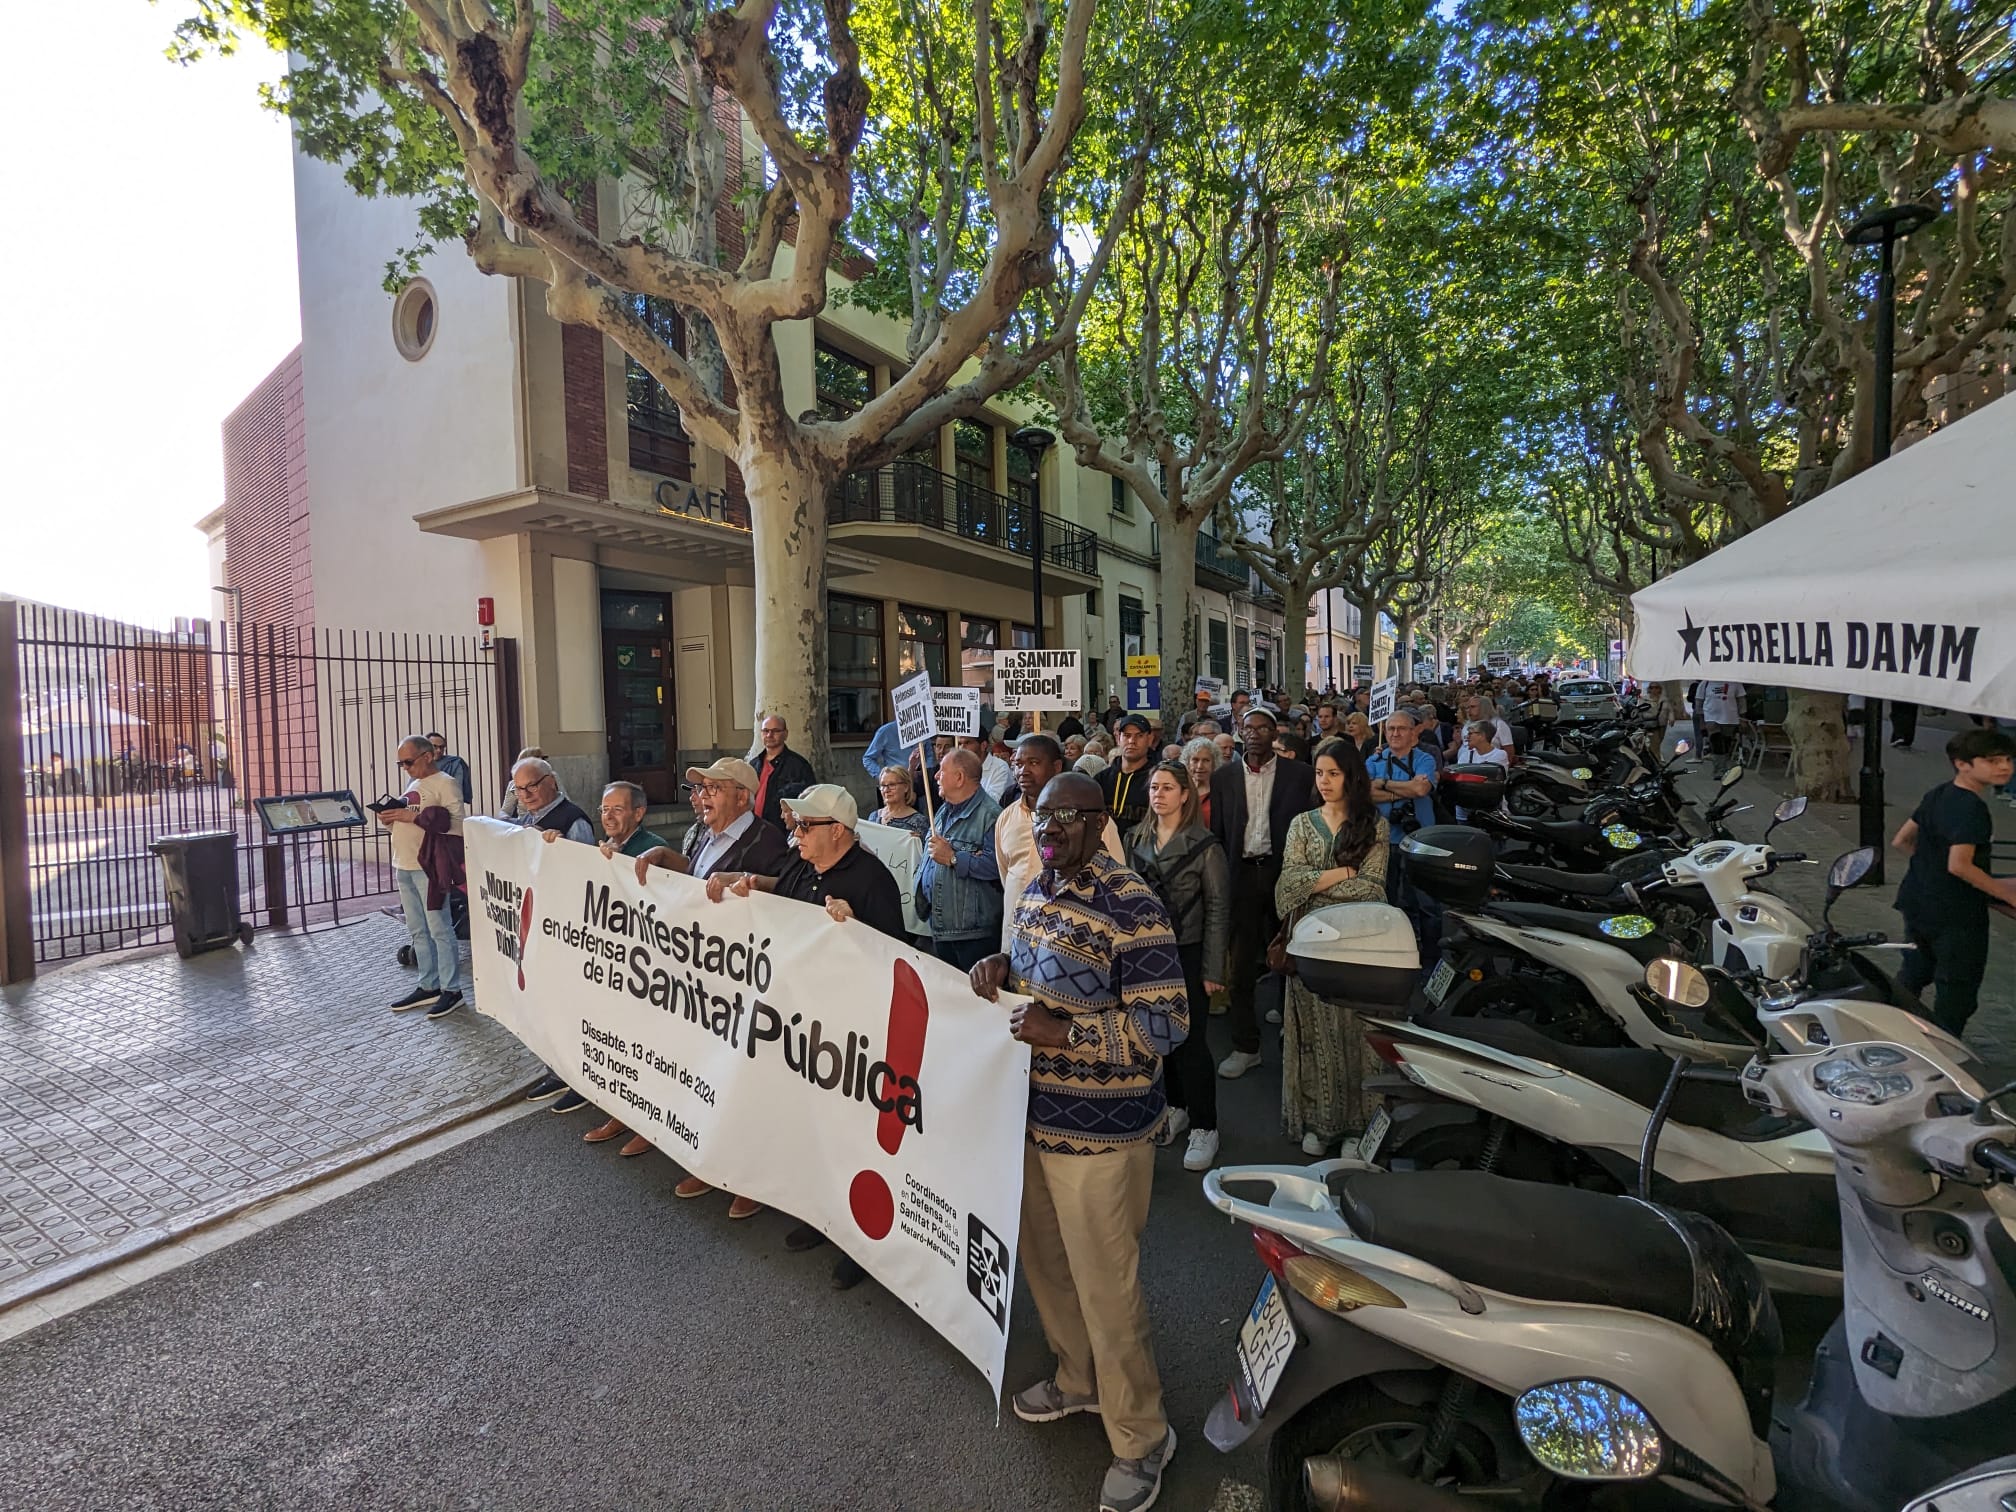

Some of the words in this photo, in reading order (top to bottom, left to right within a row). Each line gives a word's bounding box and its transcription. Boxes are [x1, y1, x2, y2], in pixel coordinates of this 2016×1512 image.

[998, 668, 1010, 679] no
[1028, 669, 1041, 679] un
[1005, 656, 1015, 668] la
[1018, 651, 1077, 668] SANITAT
[1709, 621, 1834, 667] ESTRELLA
[1846, 621, 1981, 683] DAMM
[934, 691, 962, 700] defensem
[1004, 675, 1063, 699] NEGOCI!
[898, 702, 922, 727] SANITAT
[934, 706, 966, 718] SANITAT
[542, 917, 561, 940] en
[563, 921, 626, 963] defensa
[583, 880, 773, 994] Manifestació
[582, 1041, 605, 1066] 18:30
[607, 1054, 639, 1082] hores
[583, 957, 604, 984] de
[609, 963, 624, 992] la
[627, 945, 745, 1049] Sanitat
[747, 999, 924, 1135] Pública
[582, 1019, 628, 1057] Dissabte,
[631, 1042, 643, 1060] 13
[645, 1049, 677, 1080] d'abril
[680, 1068, 693, 1088] de
[694, 1076, 716, 1108] 2024
[582, 1062, 607, 1090] Plaça
[666, 1110, 699, 1150] Mataró
[905, 1173, 957, 1220] Coordinadora
[910, 1191, 943, 1223] Defensa
[900, 1202, 930, 1231] Sanitat
[931, 1222, 960, 1255] Pública
[1262, 1292, 1291, 1364] 8412
[1250, 1326, 1276, 1392] GFK
